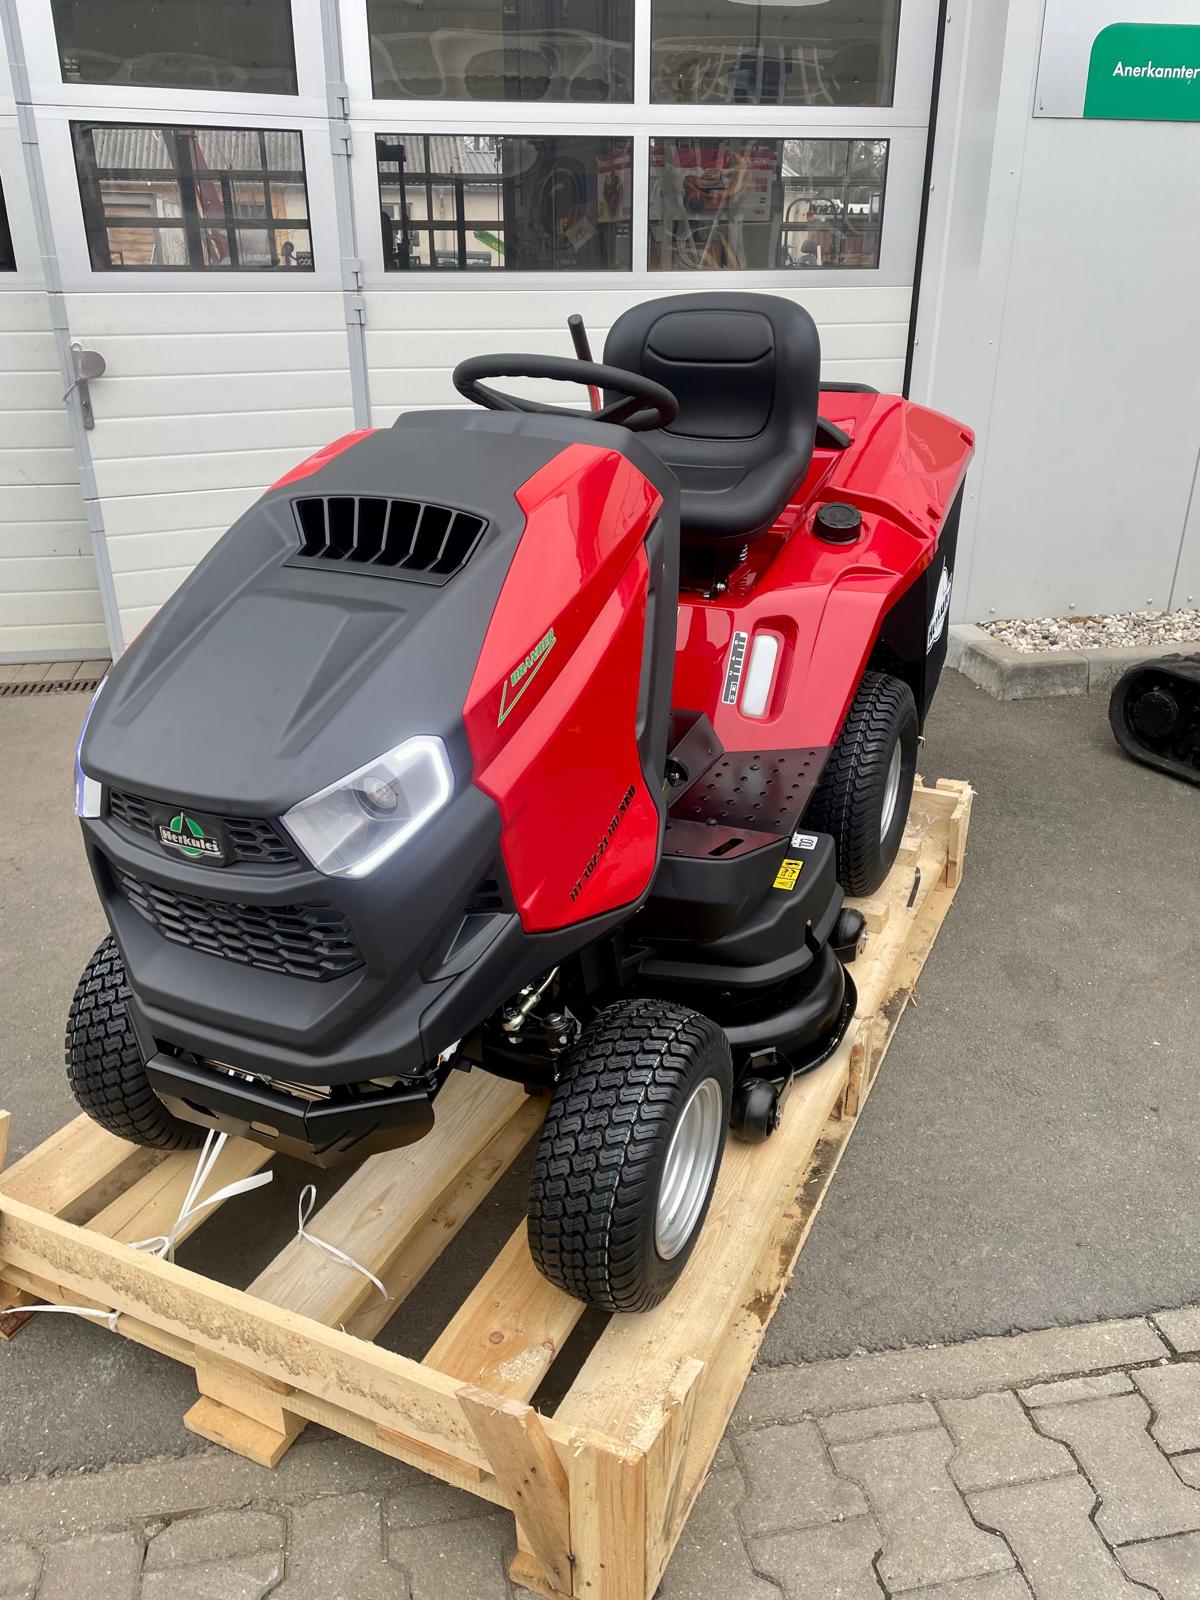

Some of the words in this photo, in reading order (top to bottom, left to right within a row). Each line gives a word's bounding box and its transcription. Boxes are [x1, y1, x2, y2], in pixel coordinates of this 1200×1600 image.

[1112, 60, 1200, 79] Anerkannter
[570, 878, 583, 902] HT
[582, 835, 609, 882] 102-21
[607, 814, 620, 837] HD
